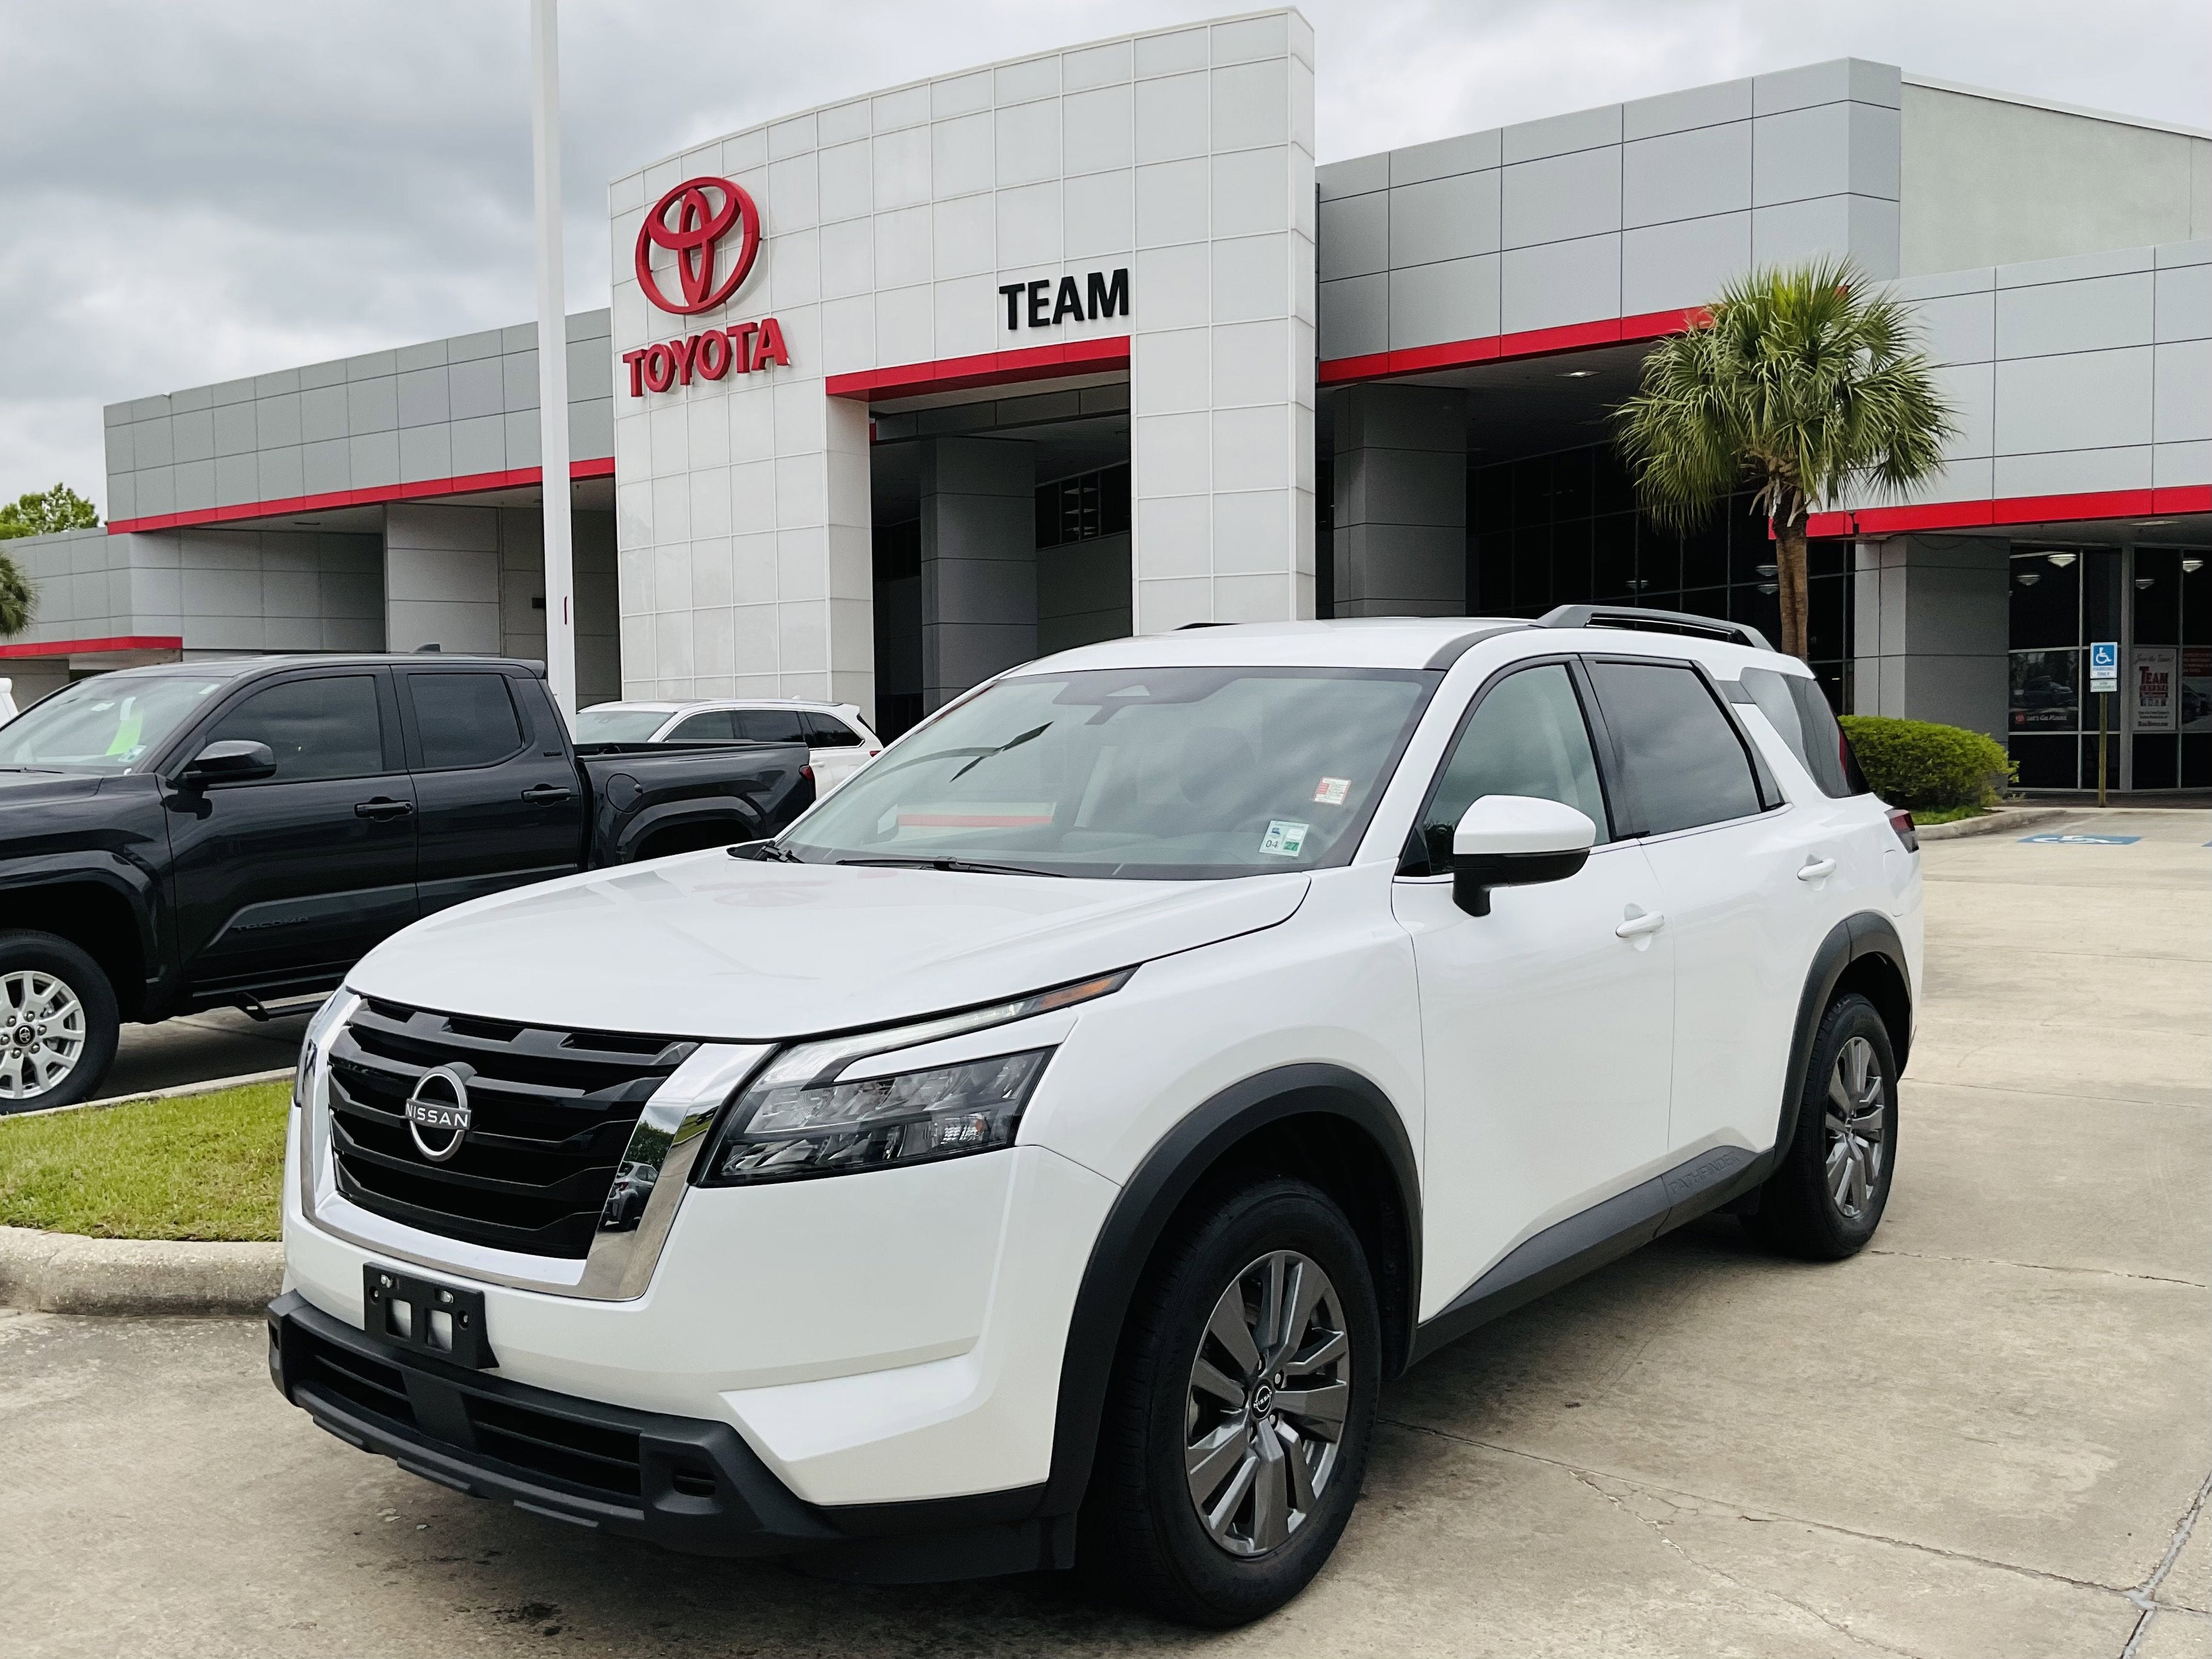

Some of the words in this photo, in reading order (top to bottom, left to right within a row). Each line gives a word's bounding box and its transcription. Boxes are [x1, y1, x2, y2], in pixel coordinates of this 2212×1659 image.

[998, 268, 1129, 330] TEAM
[622, 318, 790, 397] TOYOTA
[1266, 840, 1278, 848] 04
[1284, 841, 1300, 851] 27
[405, 1103, 468, 1128] NISSAN
[1670, 1151, 1741, 1193] PATHFINDER
